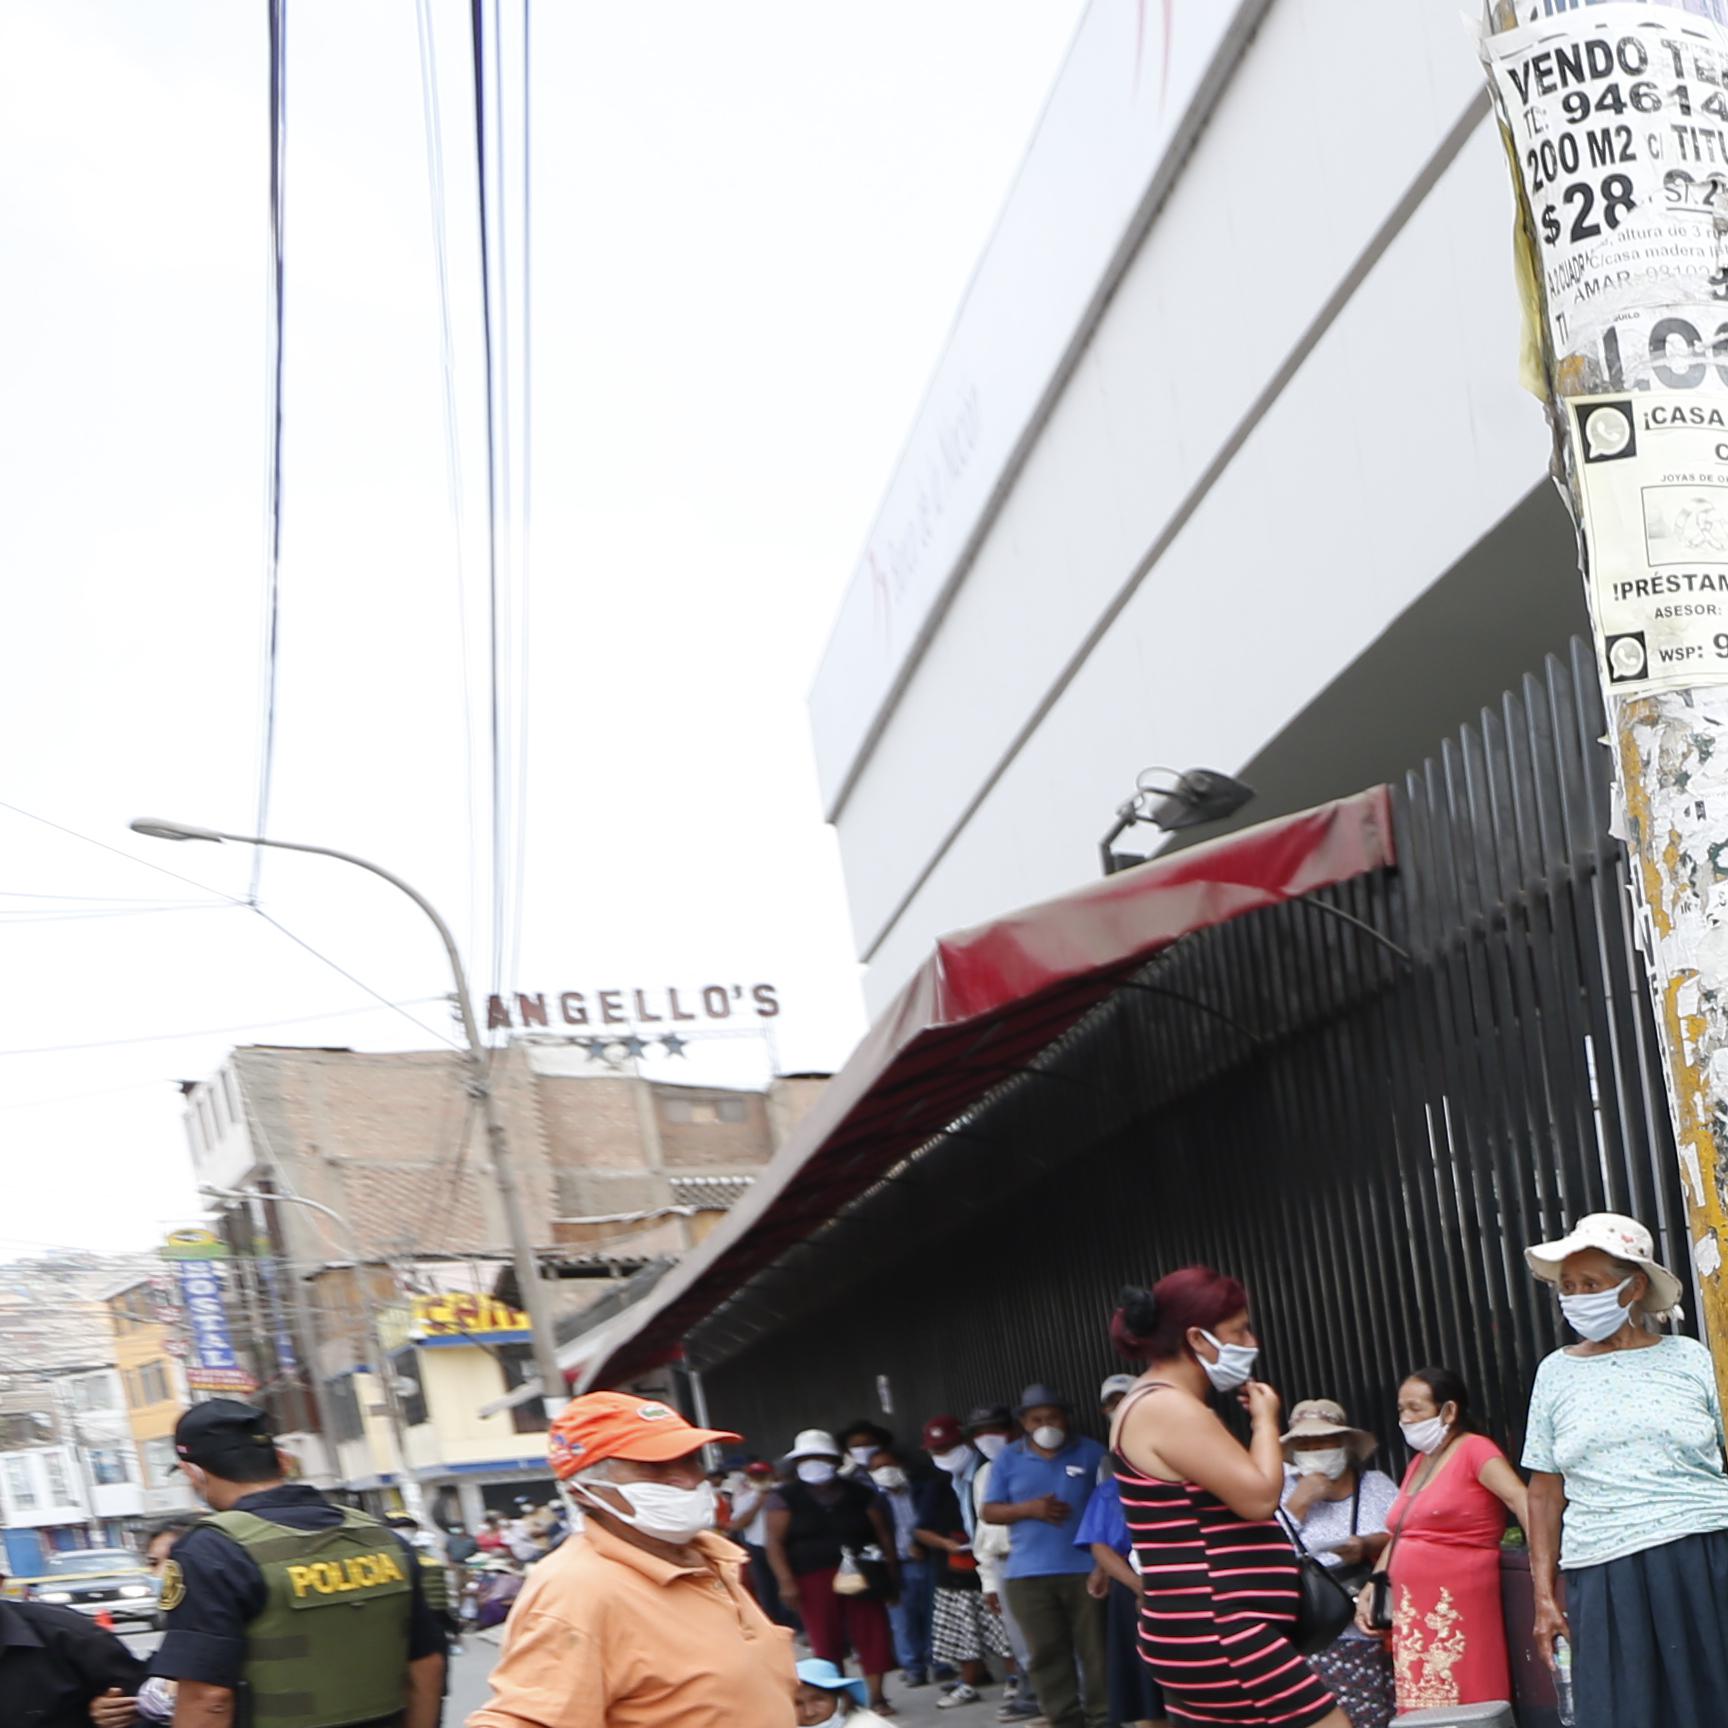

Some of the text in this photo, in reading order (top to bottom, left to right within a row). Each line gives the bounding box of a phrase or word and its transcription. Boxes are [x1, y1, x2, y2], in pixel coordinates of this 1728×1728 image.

[1507, 36, 1648, 106] VENDO
[1527, 132, 1580, 194] 200
[1586, 124, 1637, 168] M2
[1646, 245, 1706, 260] madera
[1660, 473, 1695, 484] JOYAS
[1699, 474, 1714, 484] DE
[1654, 604, 1722, 620] ASESOR:
[1659, 643, 1704, 664] WSP:
[487, 984, 779, 1031] ANGELLO'S
[287, 1551, 405, 1598] POLICIA
